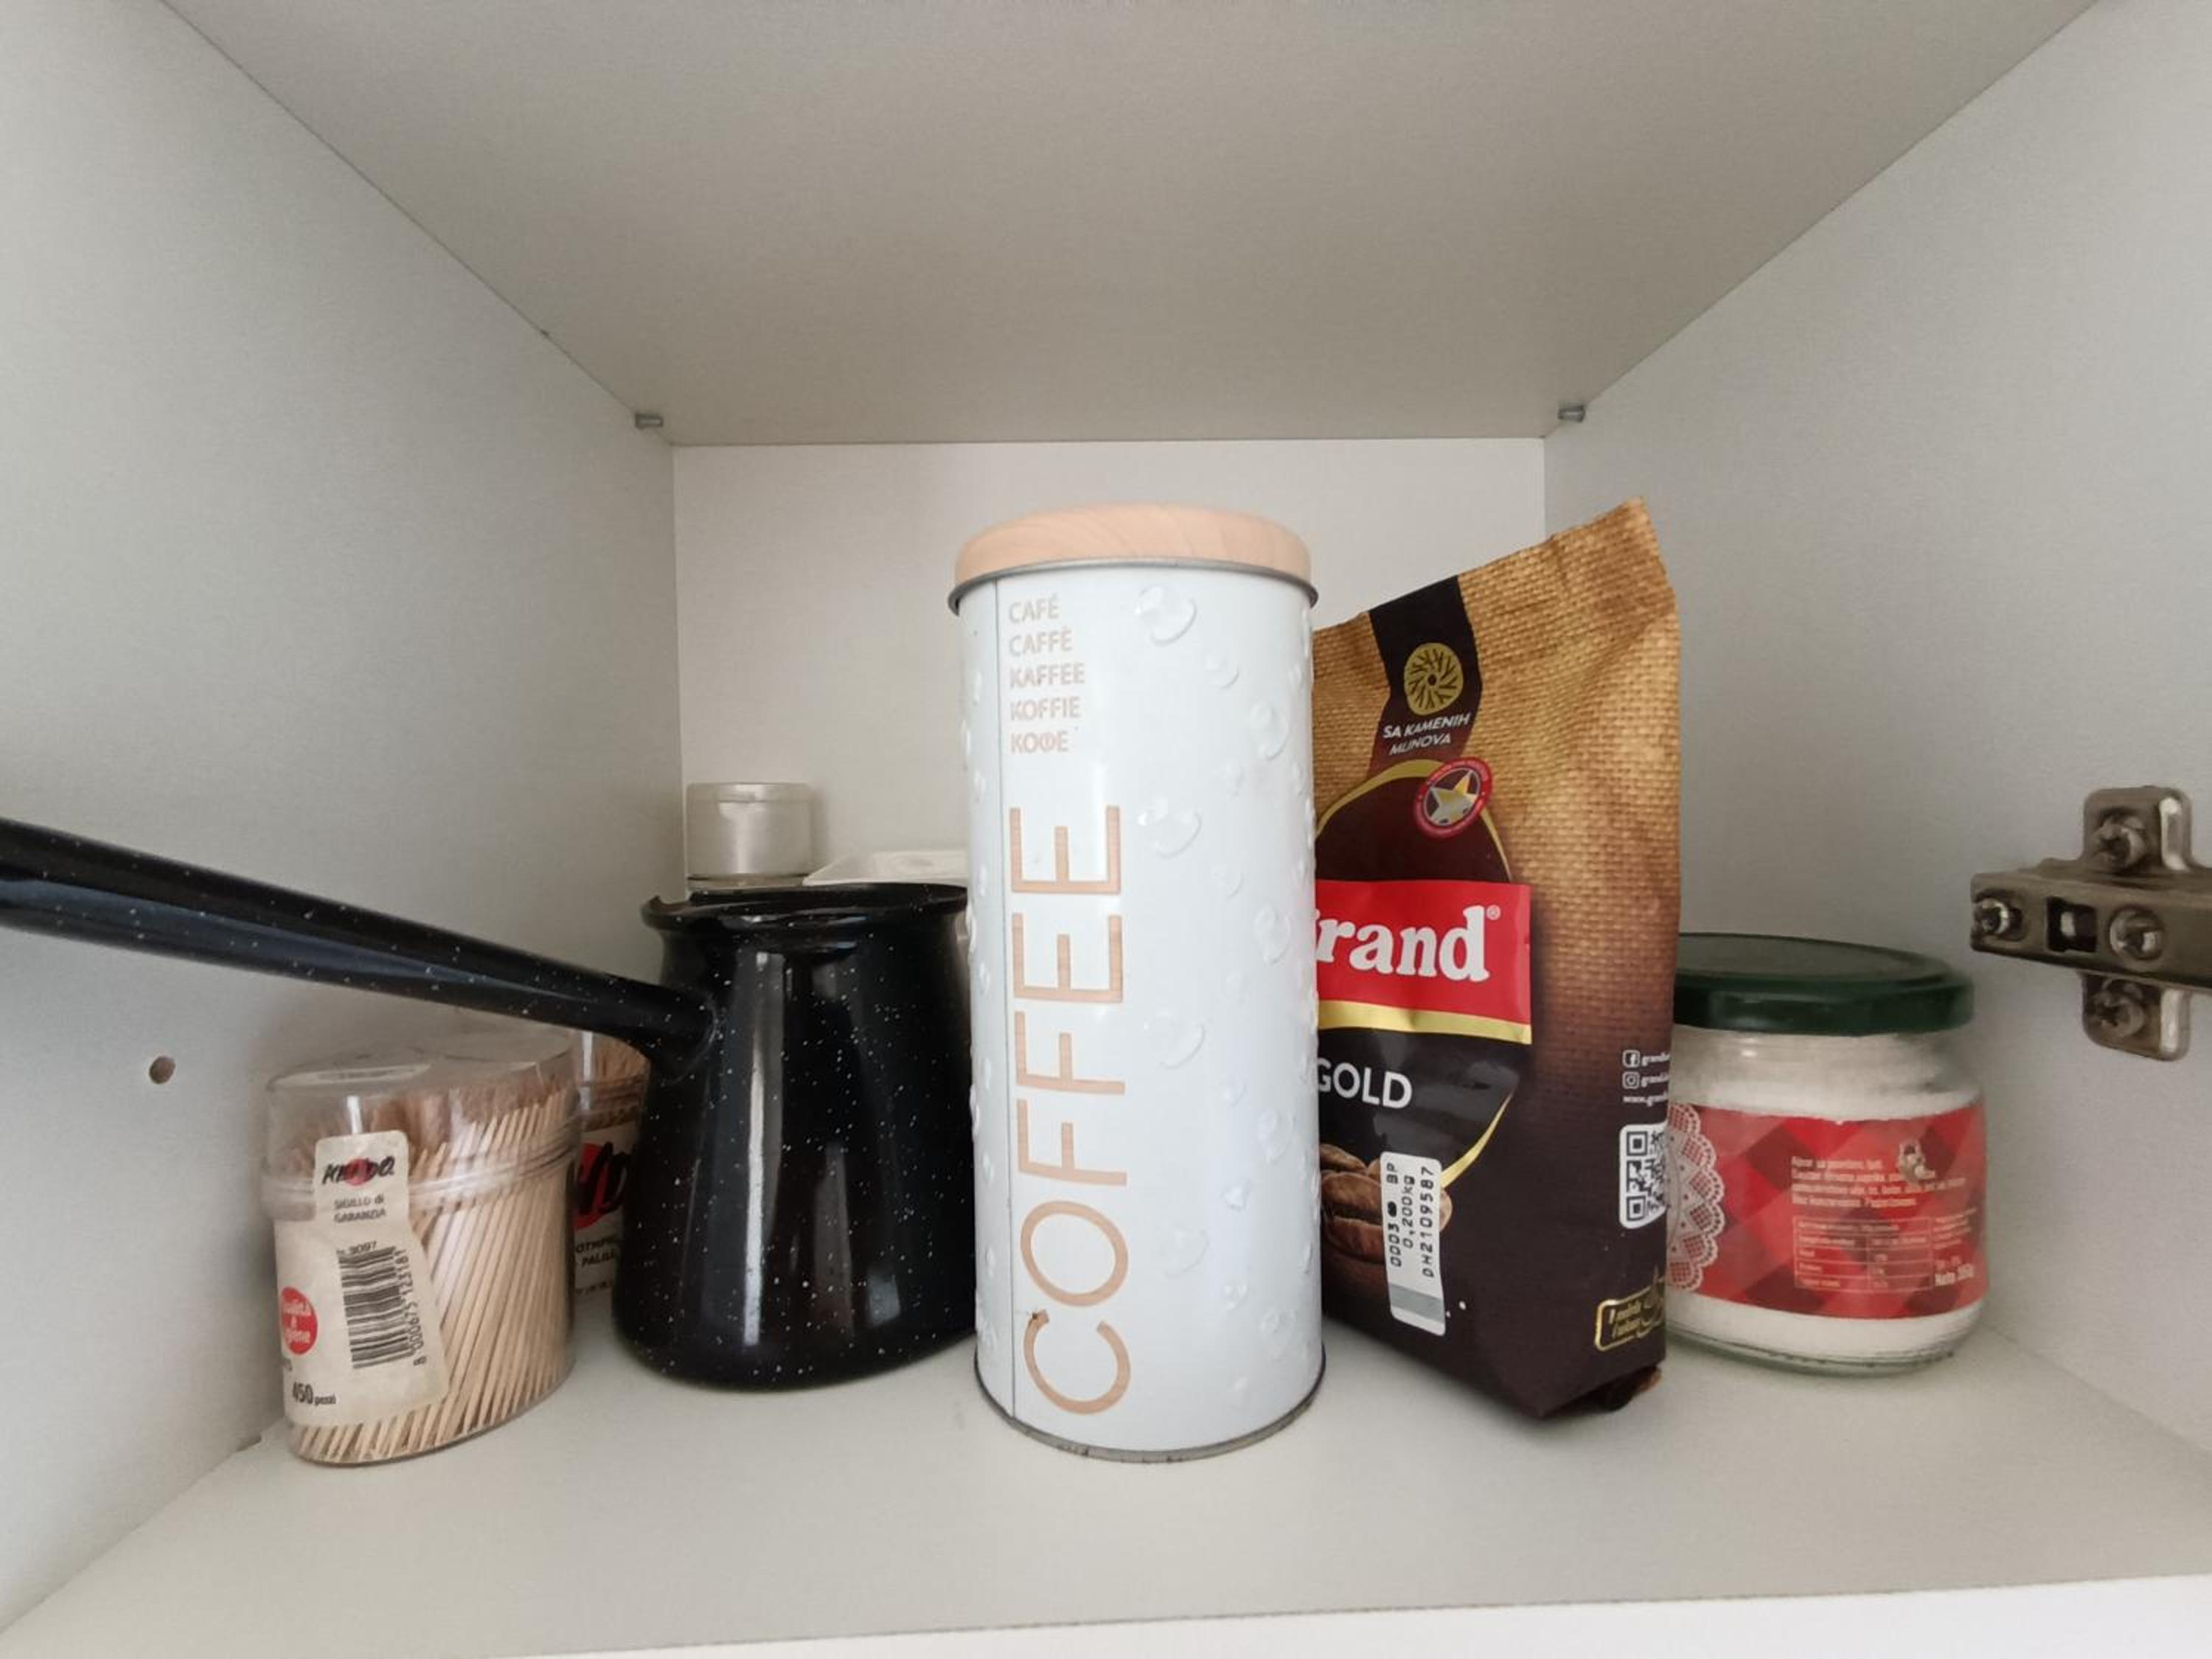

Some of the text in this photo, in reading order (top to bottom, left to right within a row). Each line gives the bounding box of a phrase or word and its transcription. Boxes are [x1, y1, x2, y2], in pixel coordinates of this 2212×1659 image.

[1009, 592, 1060, 623] CAFÉ
[1009, 662, 1085, 689] KAFFEE
[1010, 696, 1082, 720] KOFFIE
[1383, 712, 1471, 738] SA KAMENIH
[1315, 905, 1490, 982] rand
[1009, 805, 1130, 1414] COFFEE
[1388, 1222, 1402, 1267] 0003
